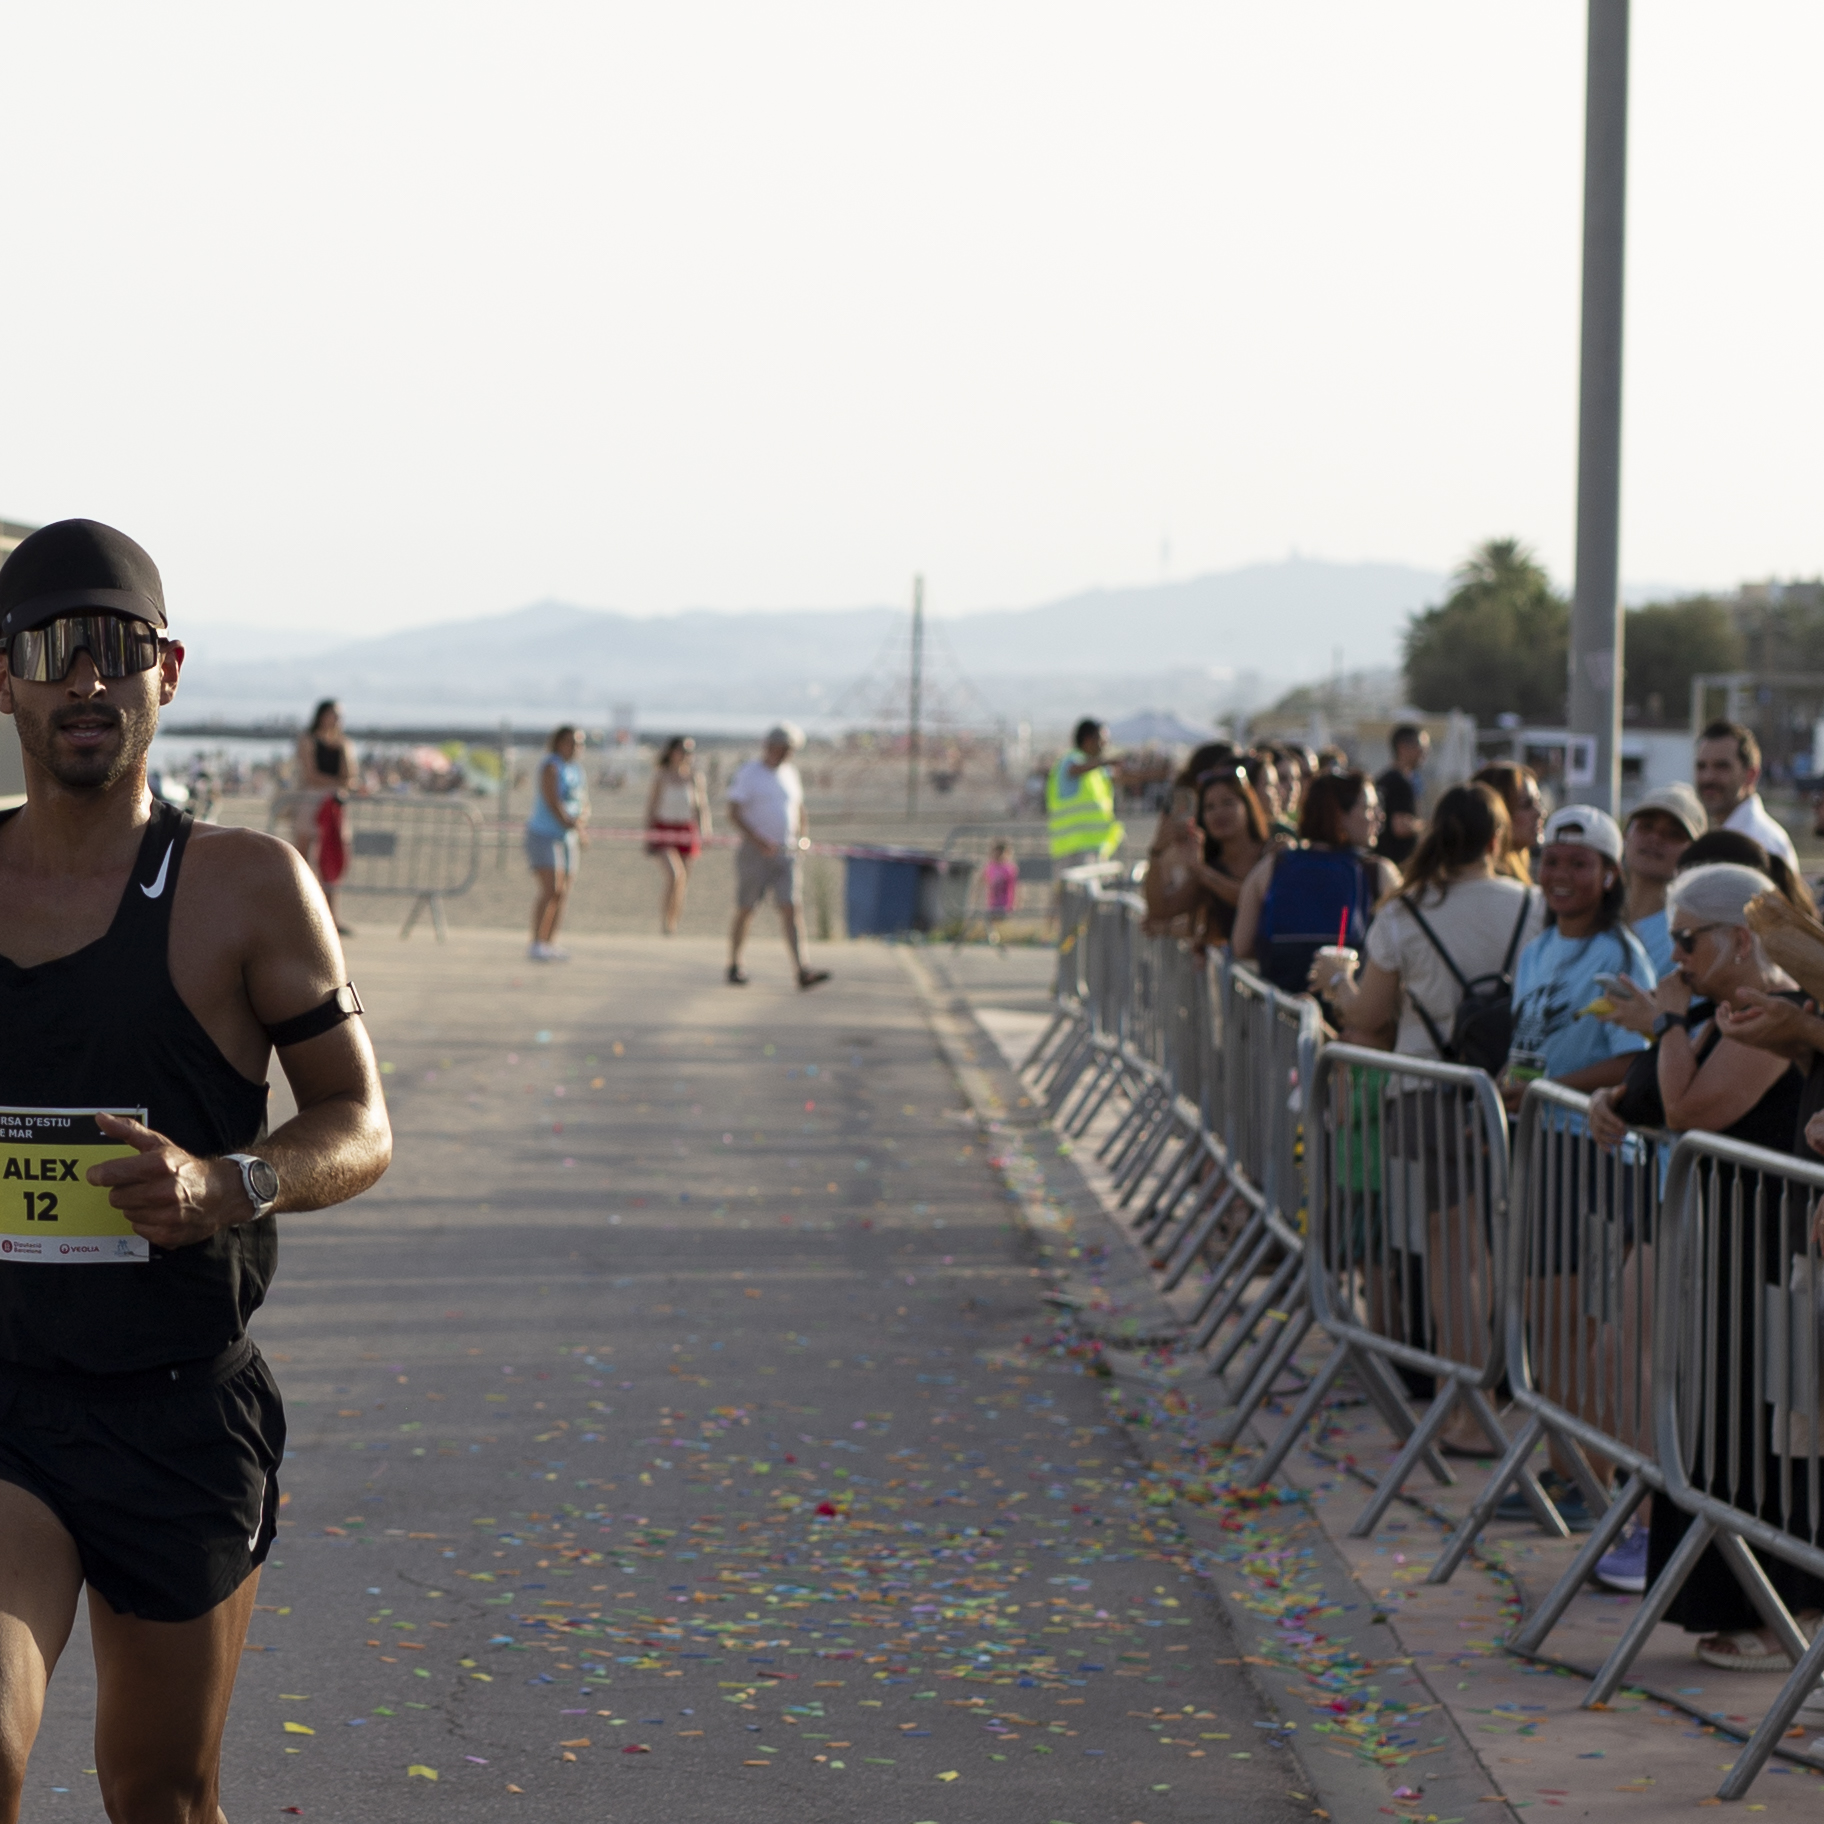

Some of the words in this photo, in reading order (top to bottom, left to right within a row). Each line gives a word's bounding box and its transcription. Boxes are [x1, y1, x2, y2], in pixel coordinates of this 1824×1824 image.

[8, 1129, 33, 1138] MAR
[3, 1158, 80, 1182] ALEX
[23, 1191, 59, 1222] 12
[70, 1245, 100, 1253] VEOLIA
